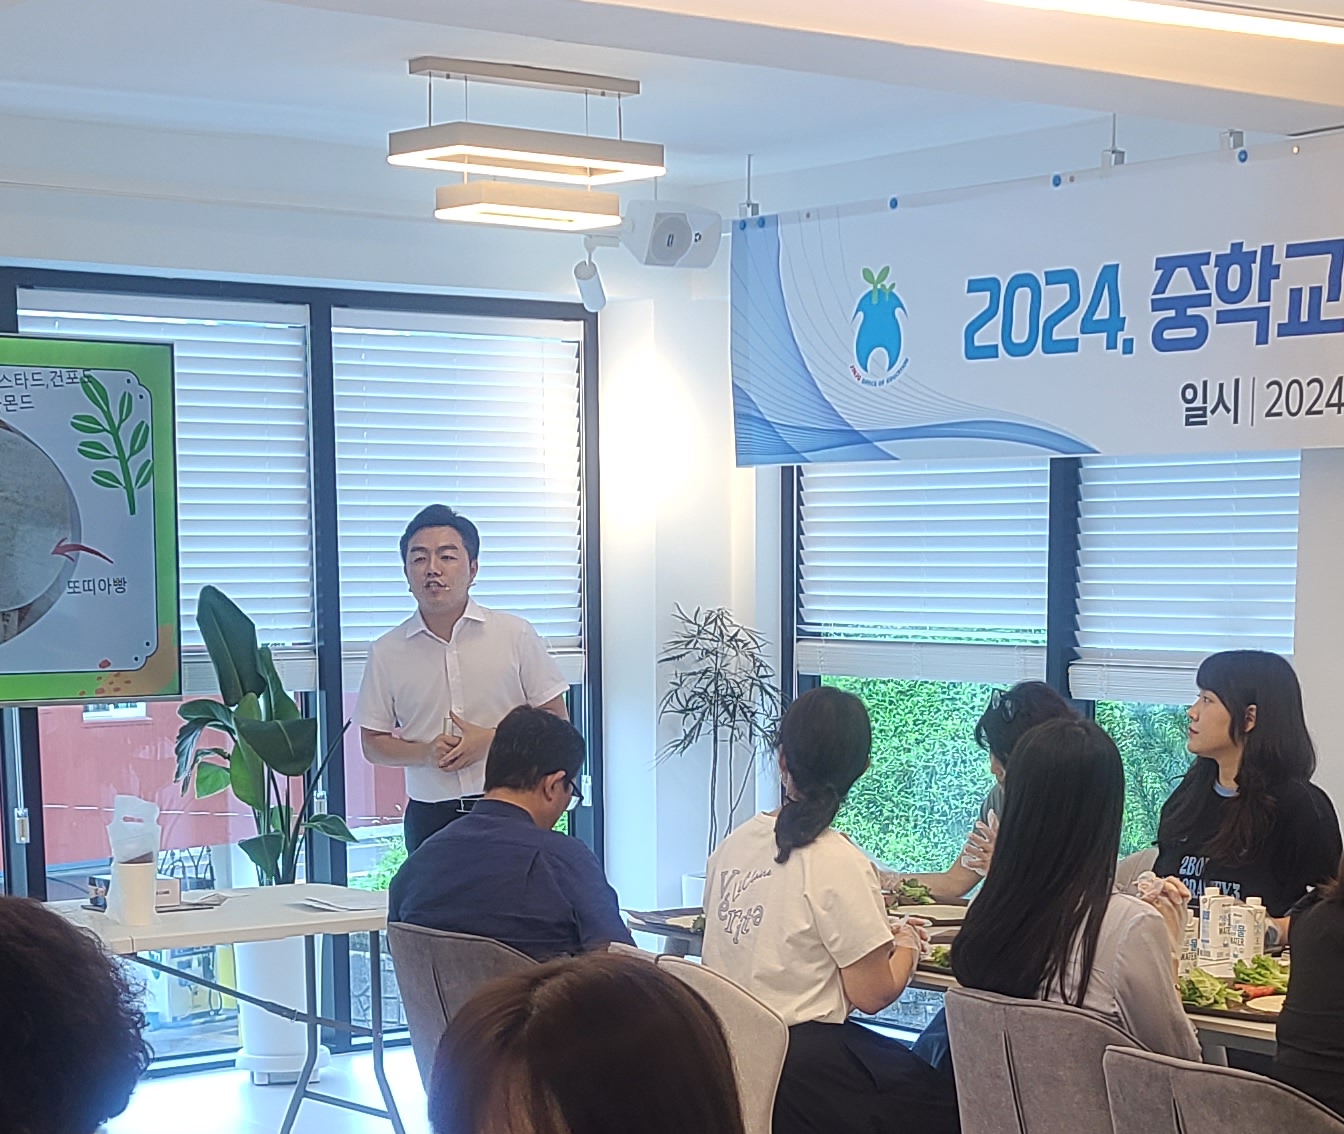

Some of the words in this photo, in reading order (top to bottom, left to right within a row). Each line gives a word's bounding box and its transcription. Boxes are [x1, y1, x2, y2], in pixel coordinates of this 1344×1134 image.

[963, 262, 1134, 361] 2024.
[1181, 379, 1242, 427] 일시
[67, 577, 127, 596] 또띠아빵
